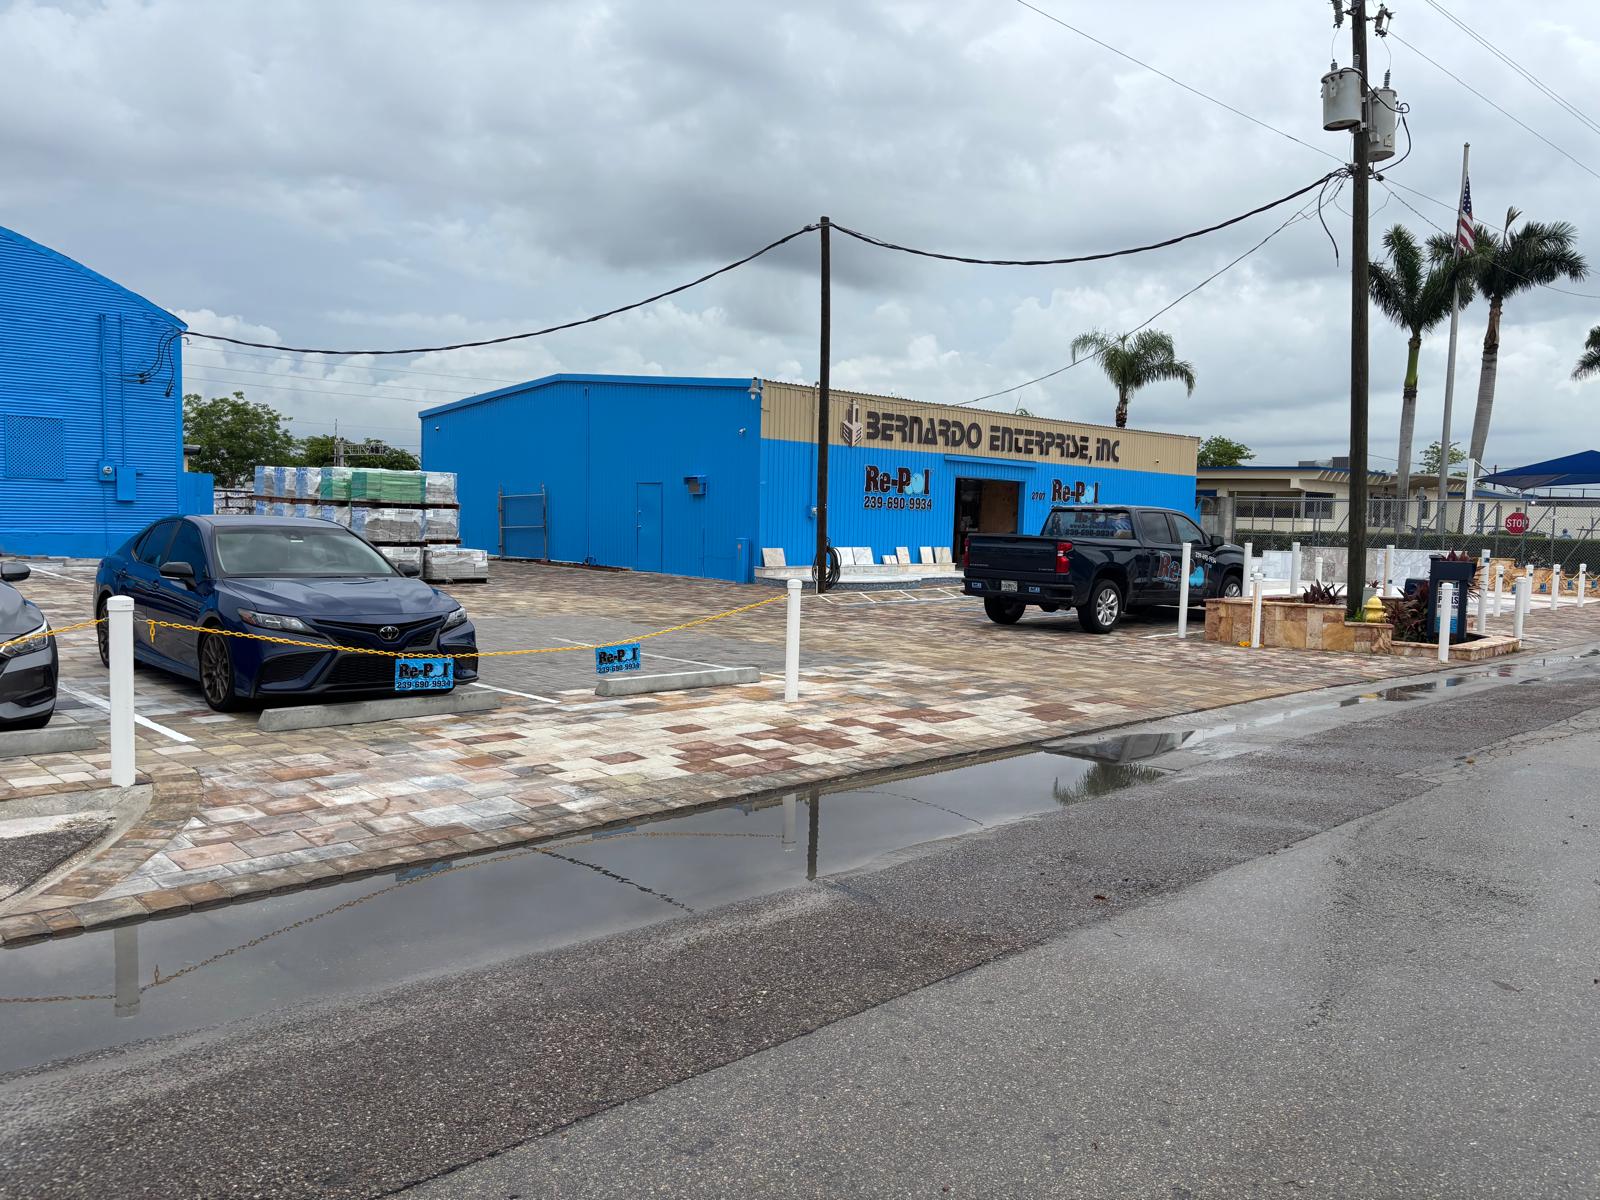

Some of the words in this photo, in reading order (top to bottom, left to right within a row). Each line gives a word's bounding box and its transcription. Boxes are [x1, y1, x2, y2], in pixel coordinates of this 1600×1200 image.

[866, 410, 982, 450] BERNARDO
[989, 425, 1093, 465] ENTERPRISE,
[1096, 437, 1120, 463] INC
[863, 496, 933, 511] 239-690-9934
[1506, 519, 1529, 528] STOP
[397, 680, 451, 690] 239-690-9934
